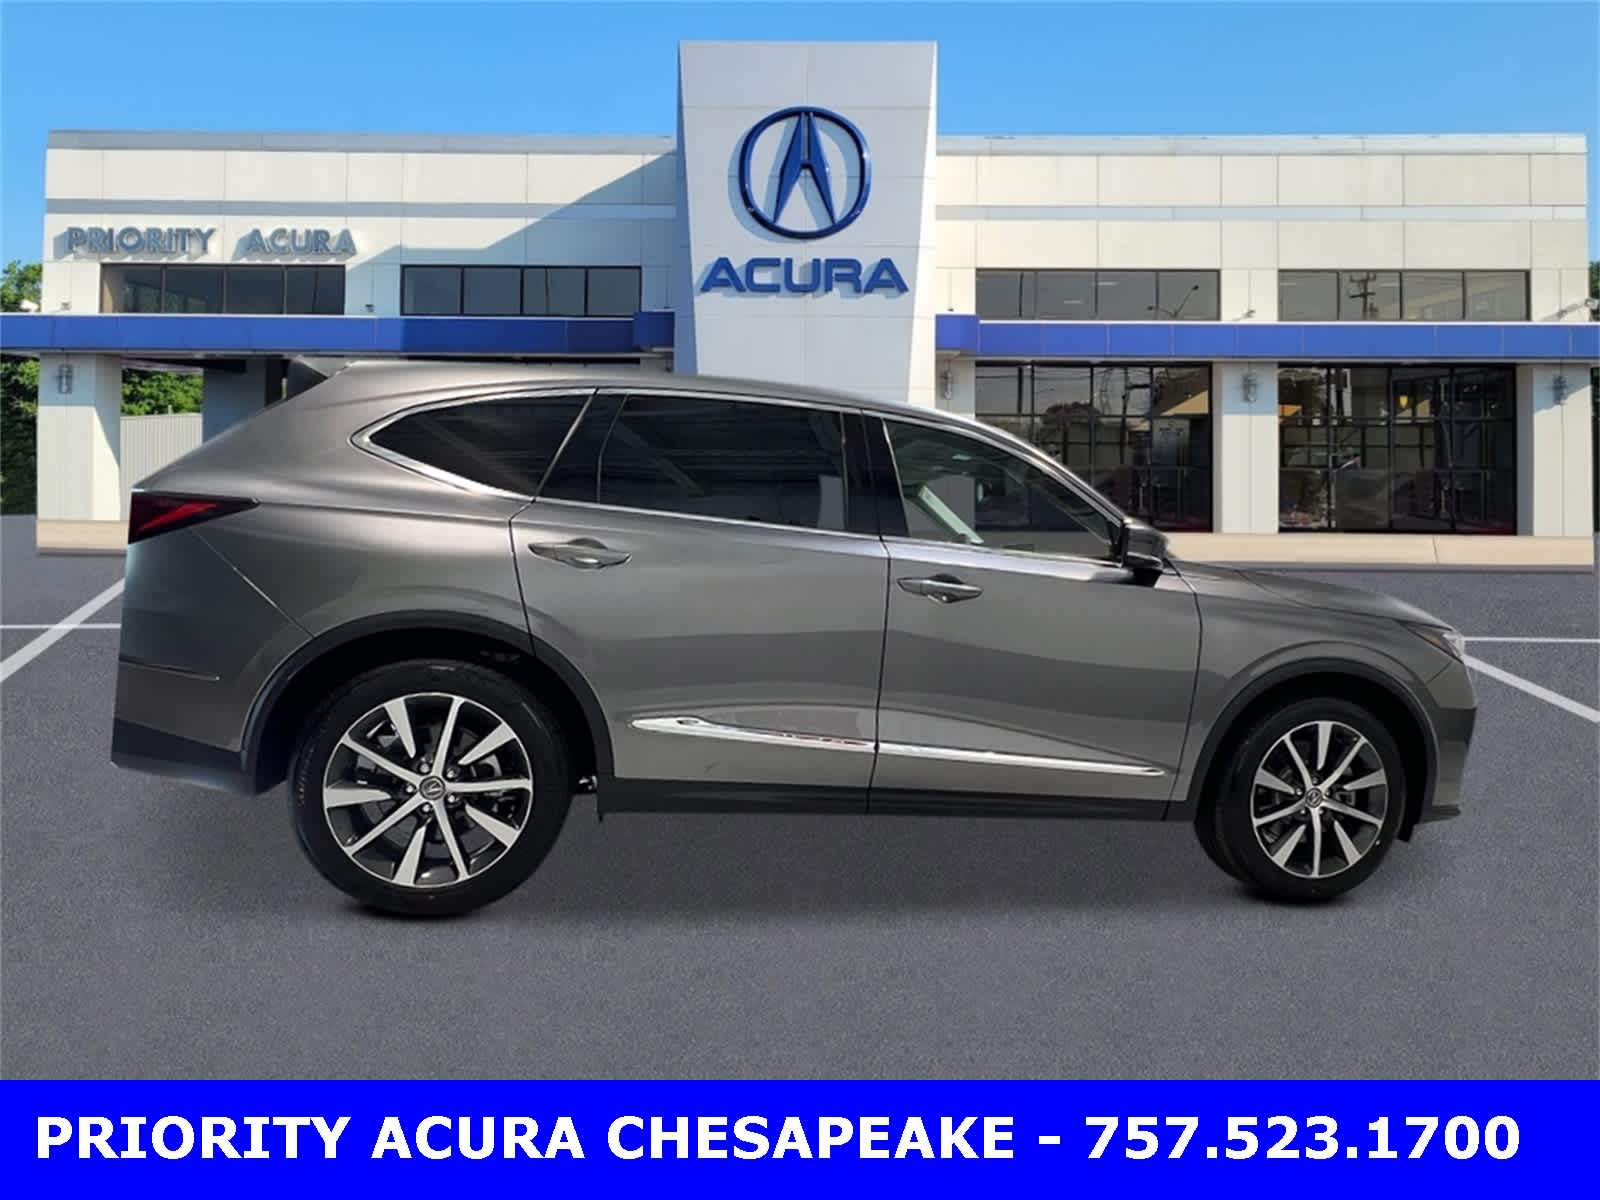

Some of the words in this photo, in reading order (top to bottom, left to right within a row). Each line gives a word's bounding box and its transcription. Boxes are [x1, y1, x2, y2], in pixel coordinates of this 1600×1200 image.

[65, 226, 216, 254] PRIORITY
[245, 227, 356, 256] ACURA
[701, 257, 909, 293] ACURA
